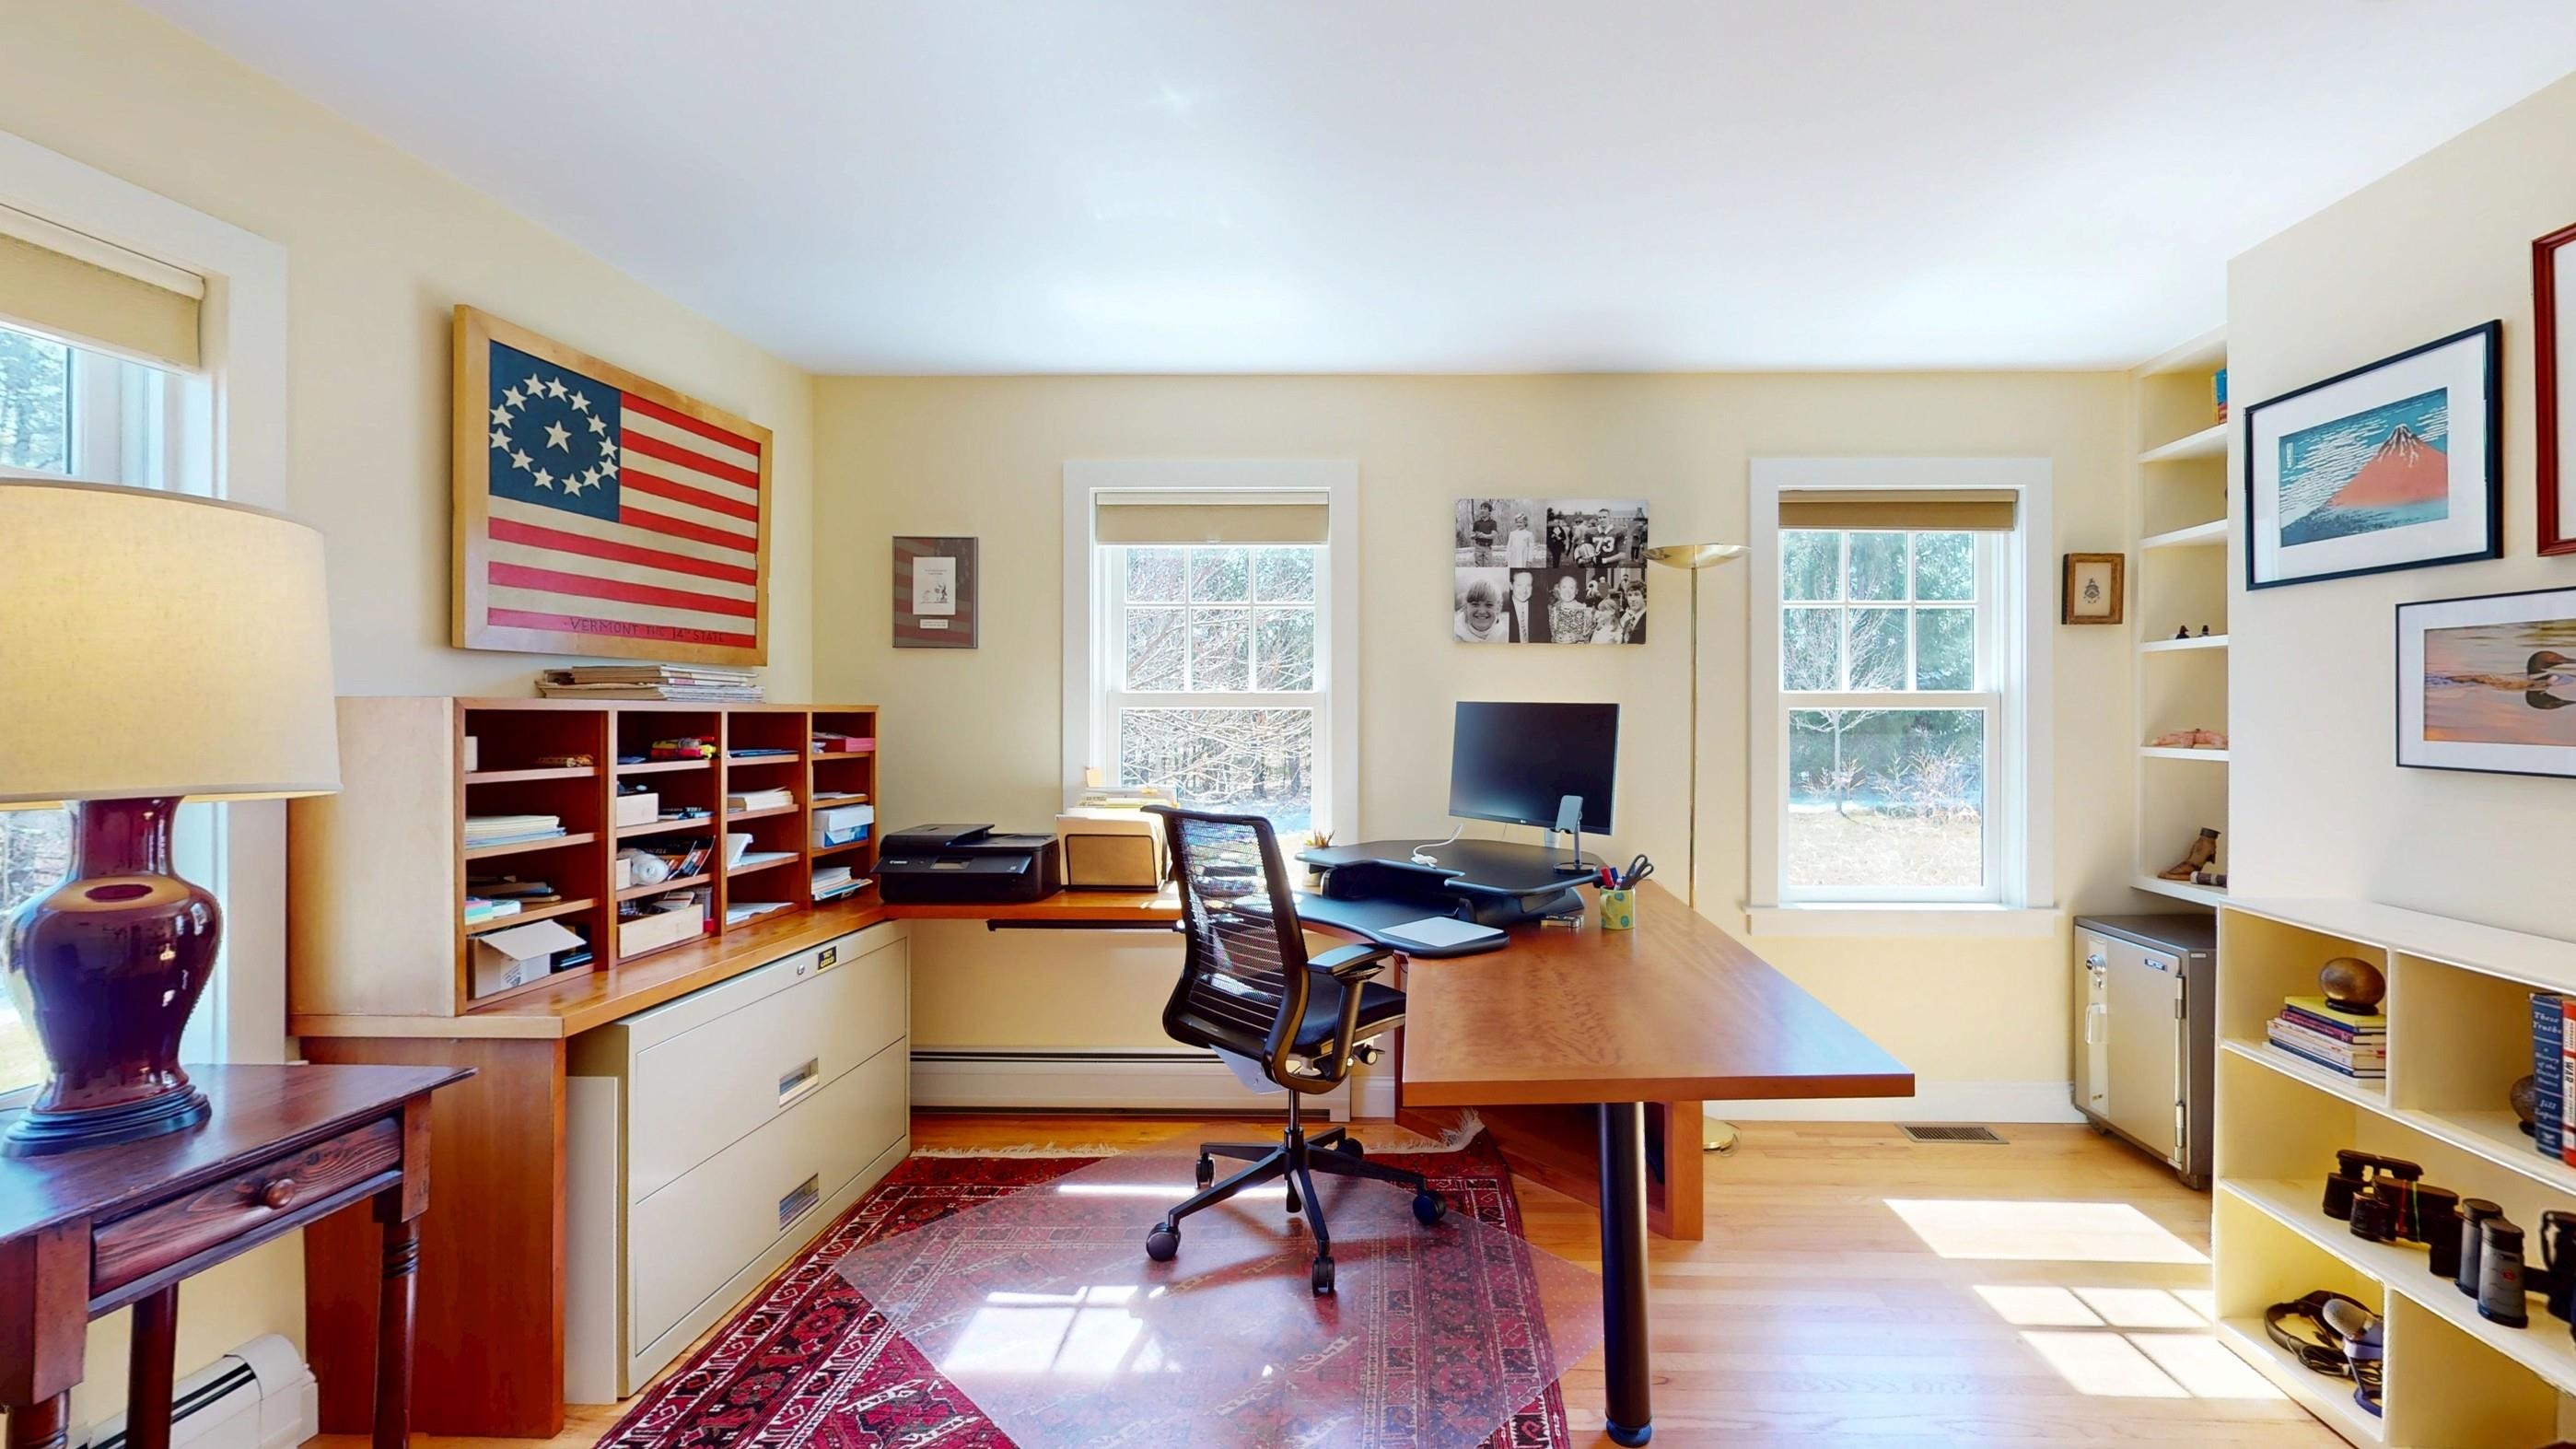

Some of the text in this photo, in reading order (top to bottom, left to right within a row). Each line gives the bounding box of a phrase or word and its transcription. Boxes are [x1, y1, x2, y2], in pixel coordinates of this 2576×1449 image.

[1592, 536, 1615, 553] 73
[570, 617, 638, 635] VERMONT
[693, 631, 723, 642] STATE
[2534, 1011, 2559, 1023] These
[2533, 1021, 2562, 1034] Truths
[2564, 1061, 2573, 1082] WAR
